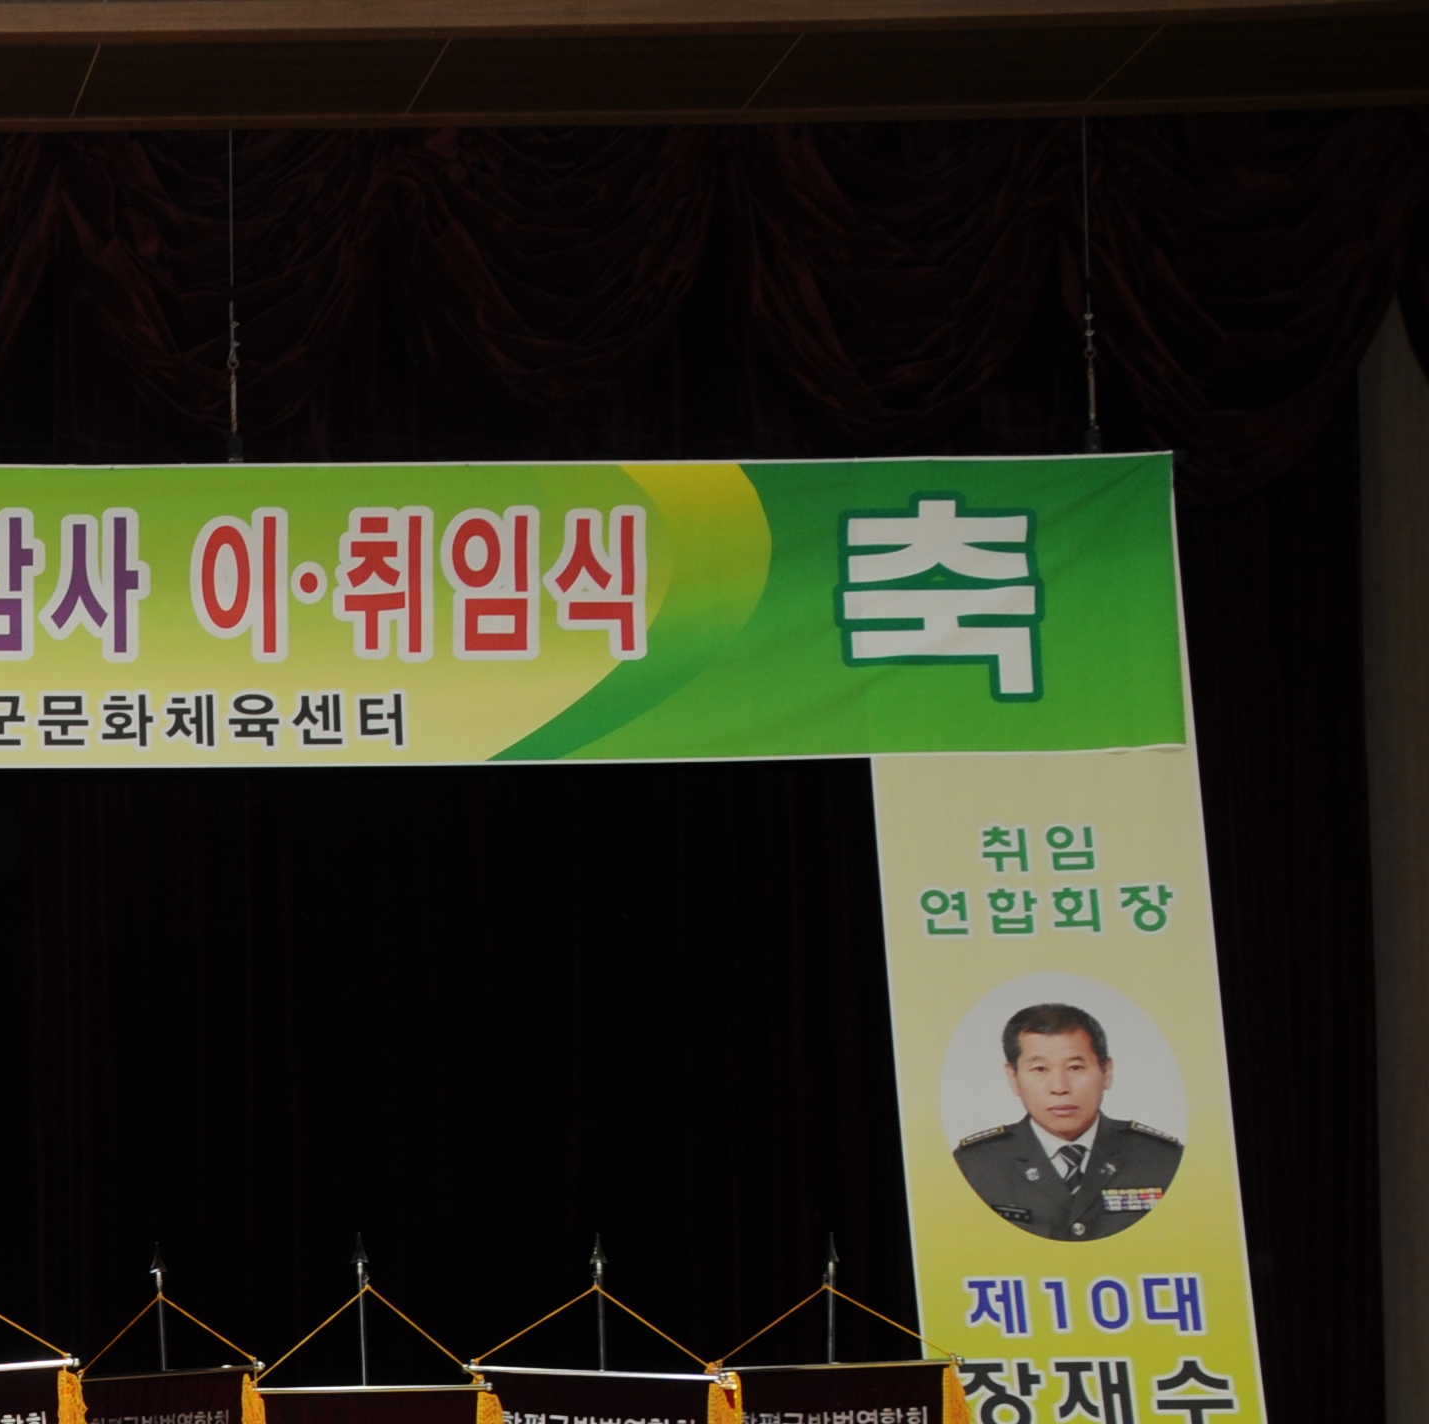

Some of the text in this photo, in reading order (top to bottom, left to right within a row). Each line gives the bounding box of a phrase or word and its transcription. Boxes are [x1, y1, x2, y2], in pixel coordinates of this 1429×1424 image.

[200, 514, 637, 655] 이·취임식
[841, 498, 1037, 695] 축
[980, 825, 1097, 872] 취임
[920, 885, 1174, 936] 연합회장
[966, 1275, 1204, 1334] 제10대
